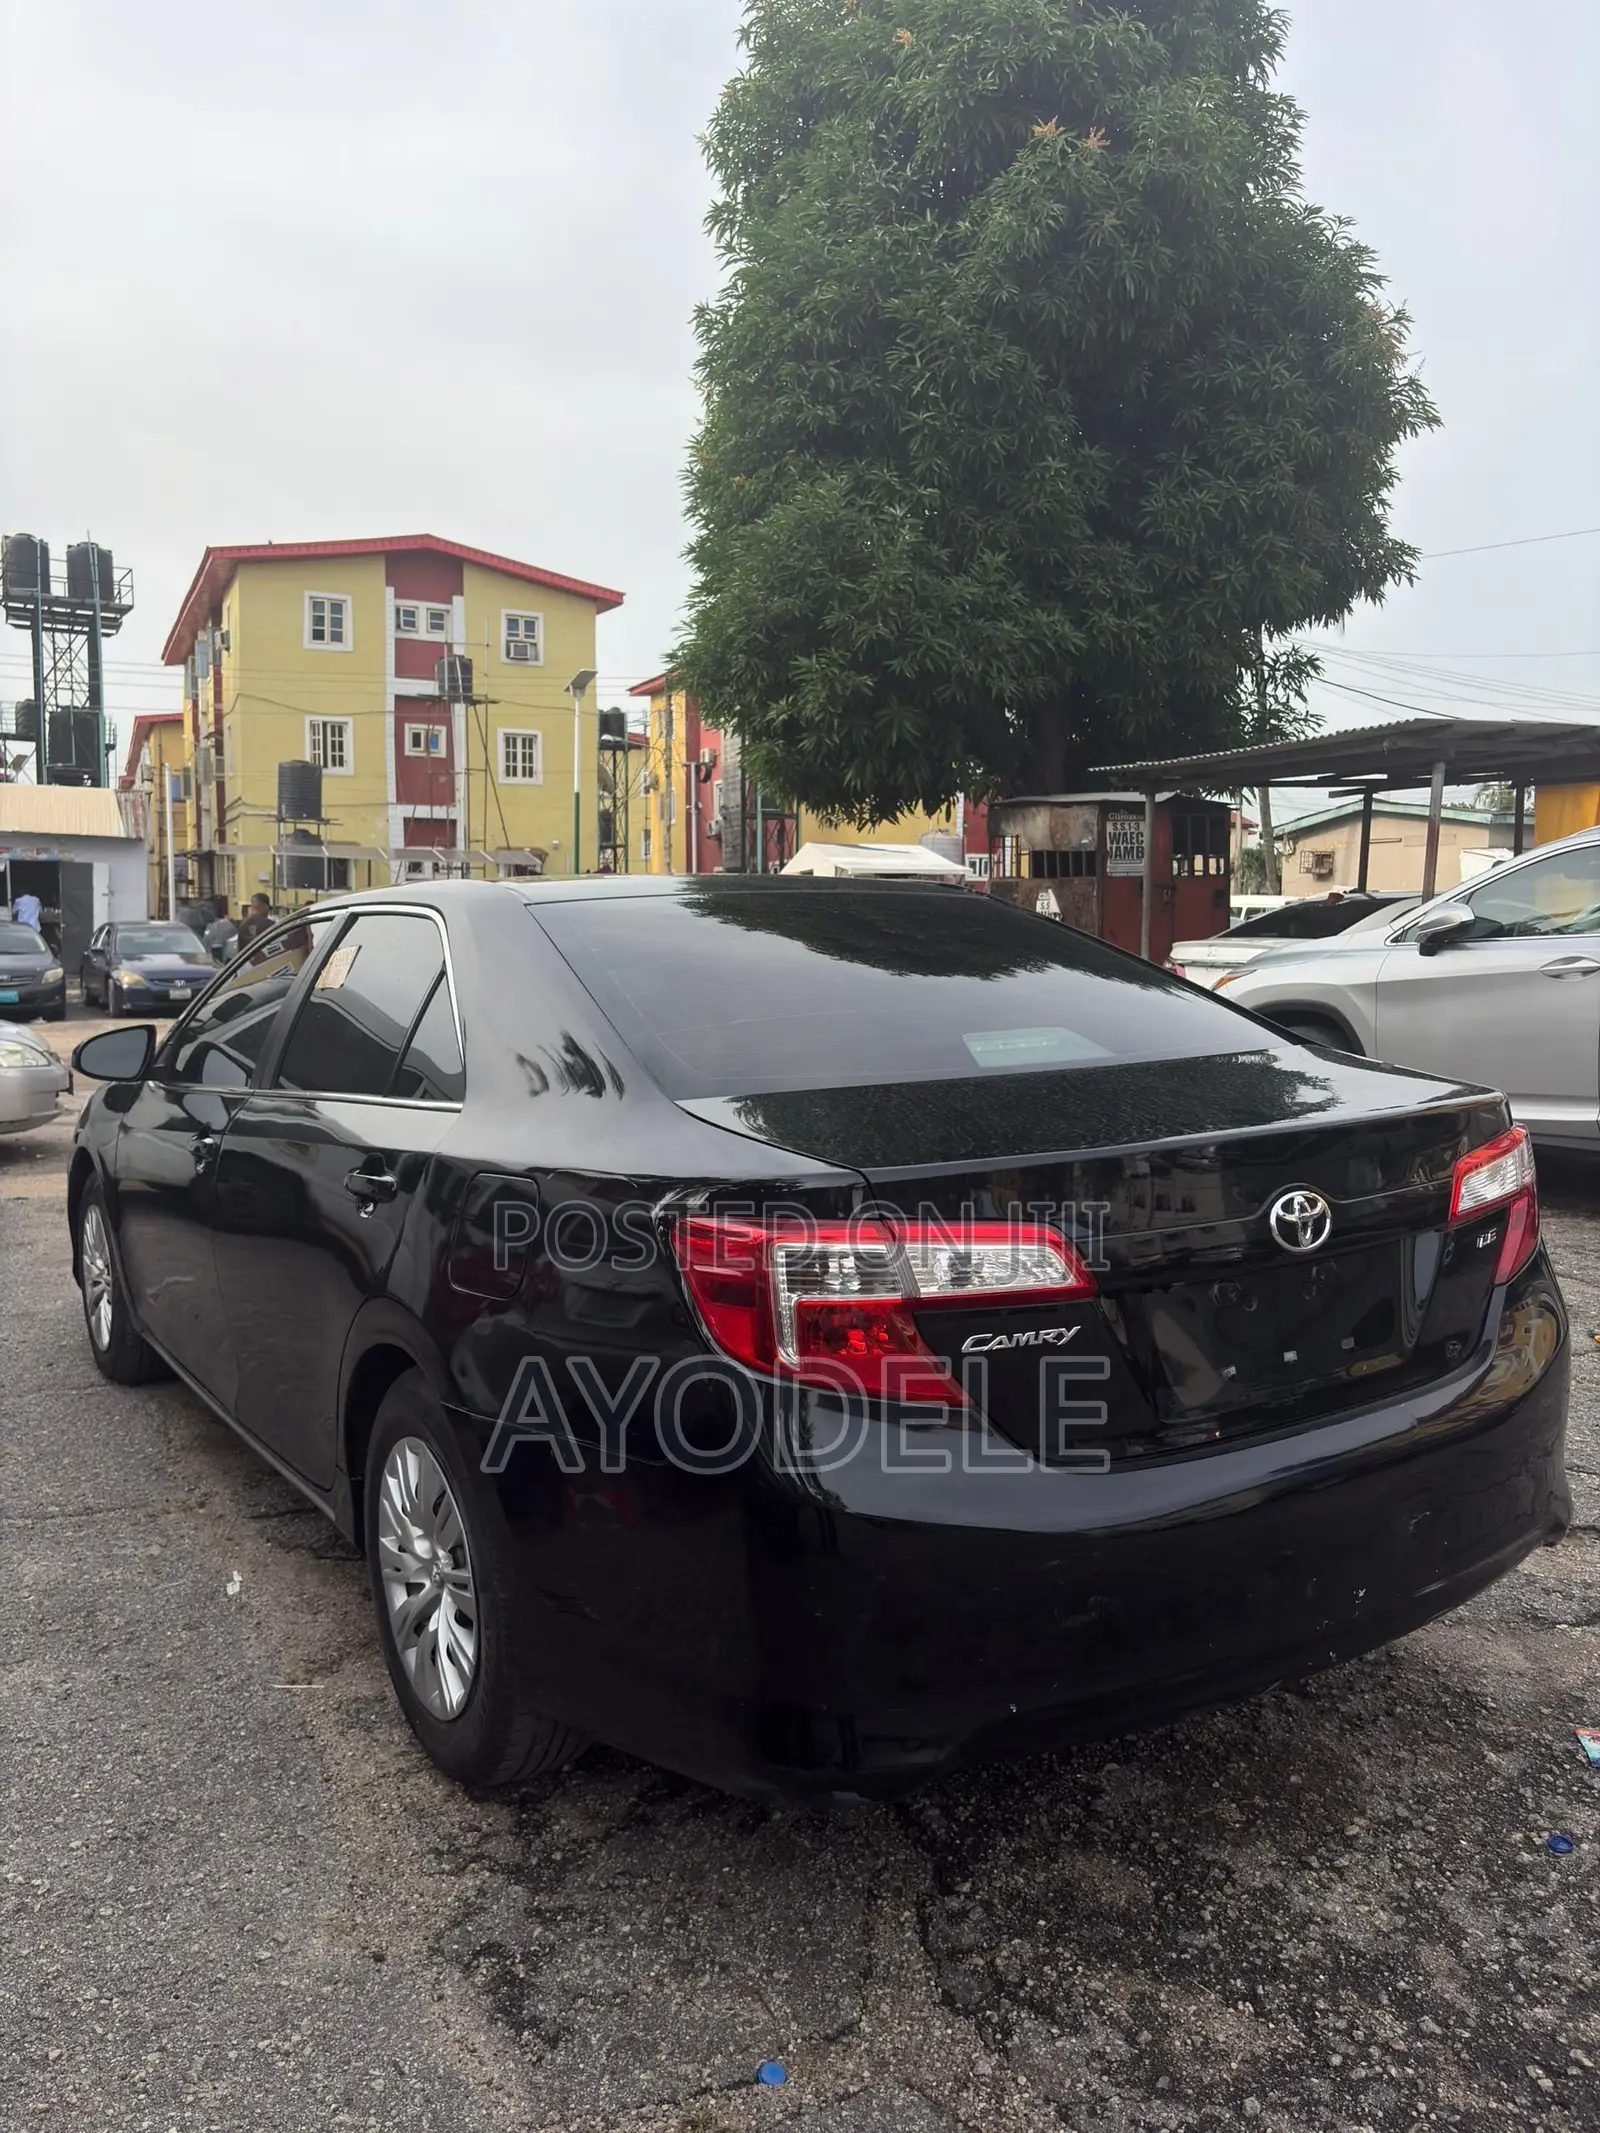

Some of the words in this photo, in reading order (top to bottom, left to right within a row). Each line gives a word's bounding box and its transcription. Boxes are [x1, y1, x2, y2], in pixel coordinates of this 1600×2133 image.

[1108, 831, 1144, 846] WAEC
[1108, 845, 1145, 860] JAMB
[961, 1325, 1082, 1353] CAMRY
